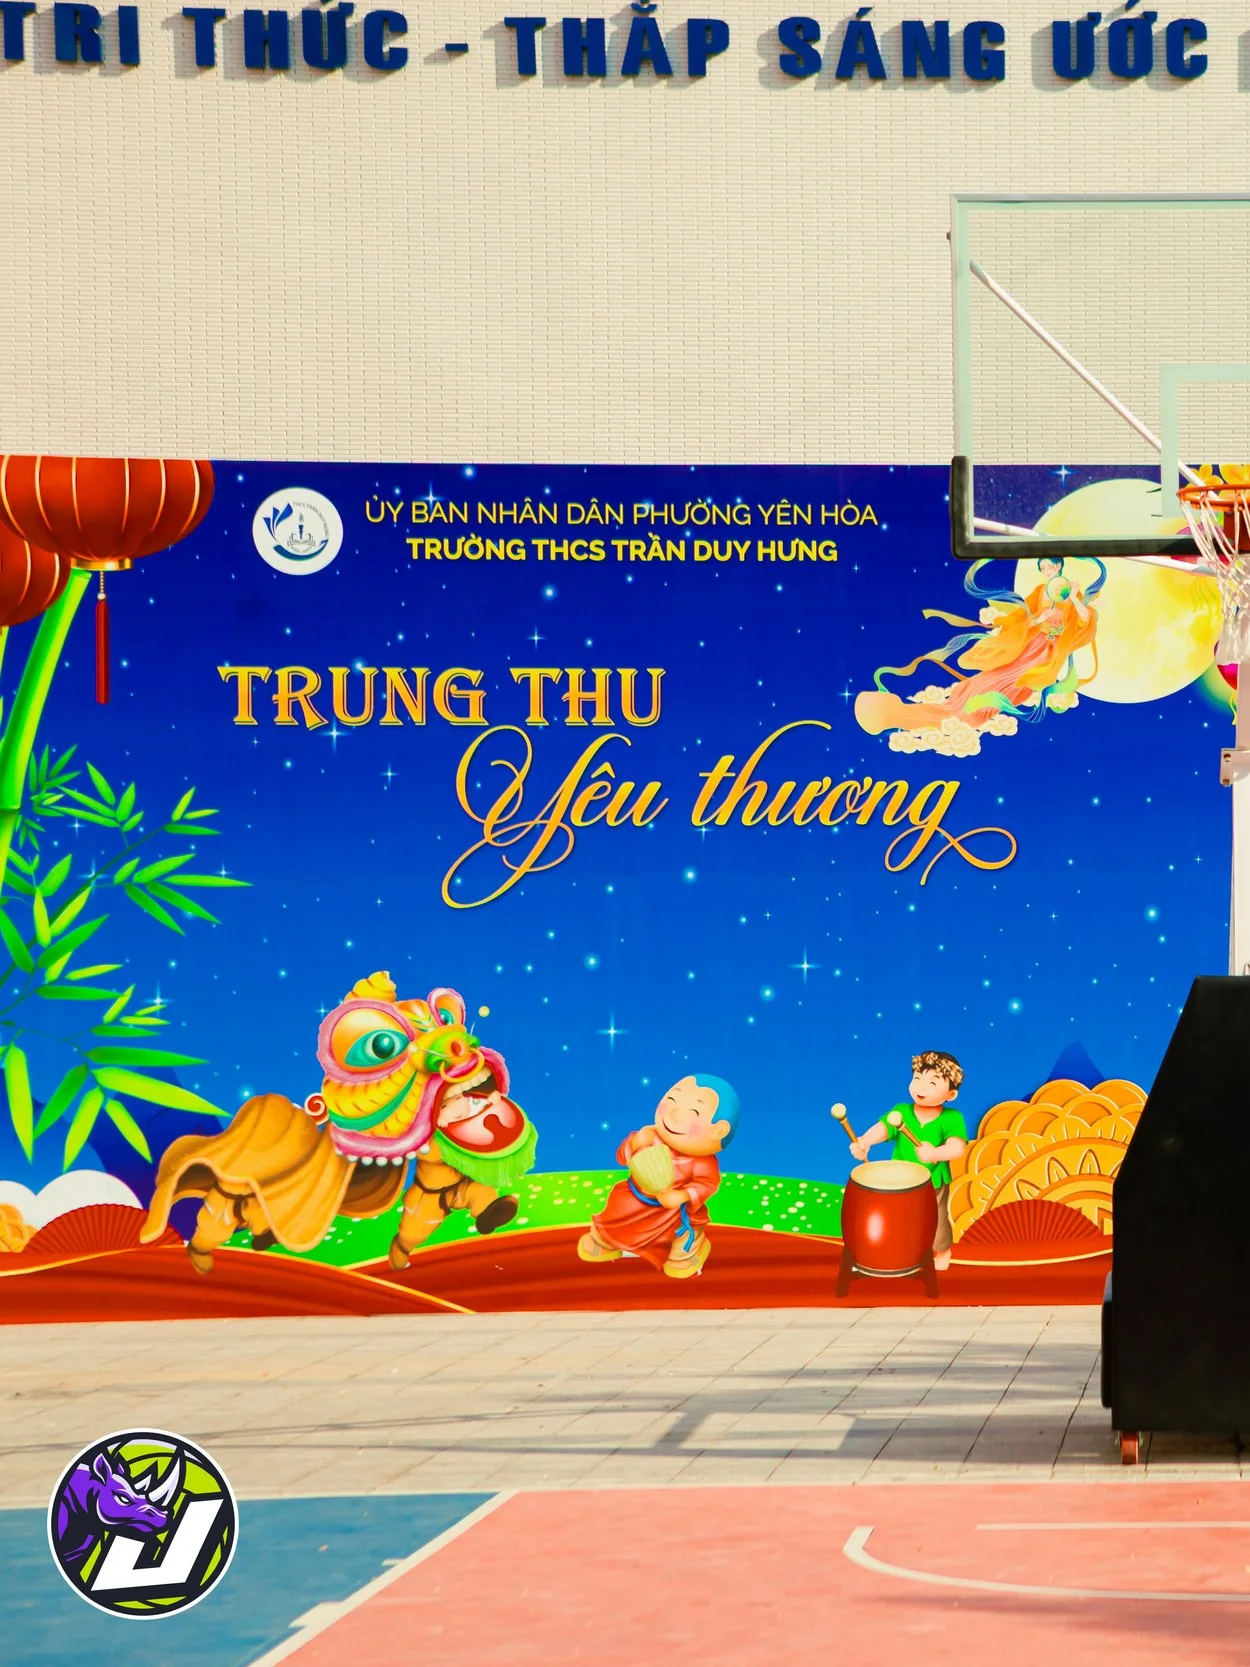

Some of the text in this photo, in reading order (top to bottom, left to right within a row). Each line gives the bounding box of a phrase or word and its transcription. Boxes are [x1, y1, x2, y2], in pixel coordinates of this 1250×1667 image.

[0, 1, 140, 65] TRI
[778, 6, 1006, 81] SÁNG
[1052, 0, 1208, 80] ƯỚC
[365, 494, 878, 525] ỦY BAN NHÂN DÂN PHƯỜNG YÊN HÒA
[406, 532, 838, 562] TRƯỜNG THCS TRẦN DUY HƯNG
[216, 664, 665, 730] TRUNG THU
[441, 720, 1017, 909] Yêu thương
